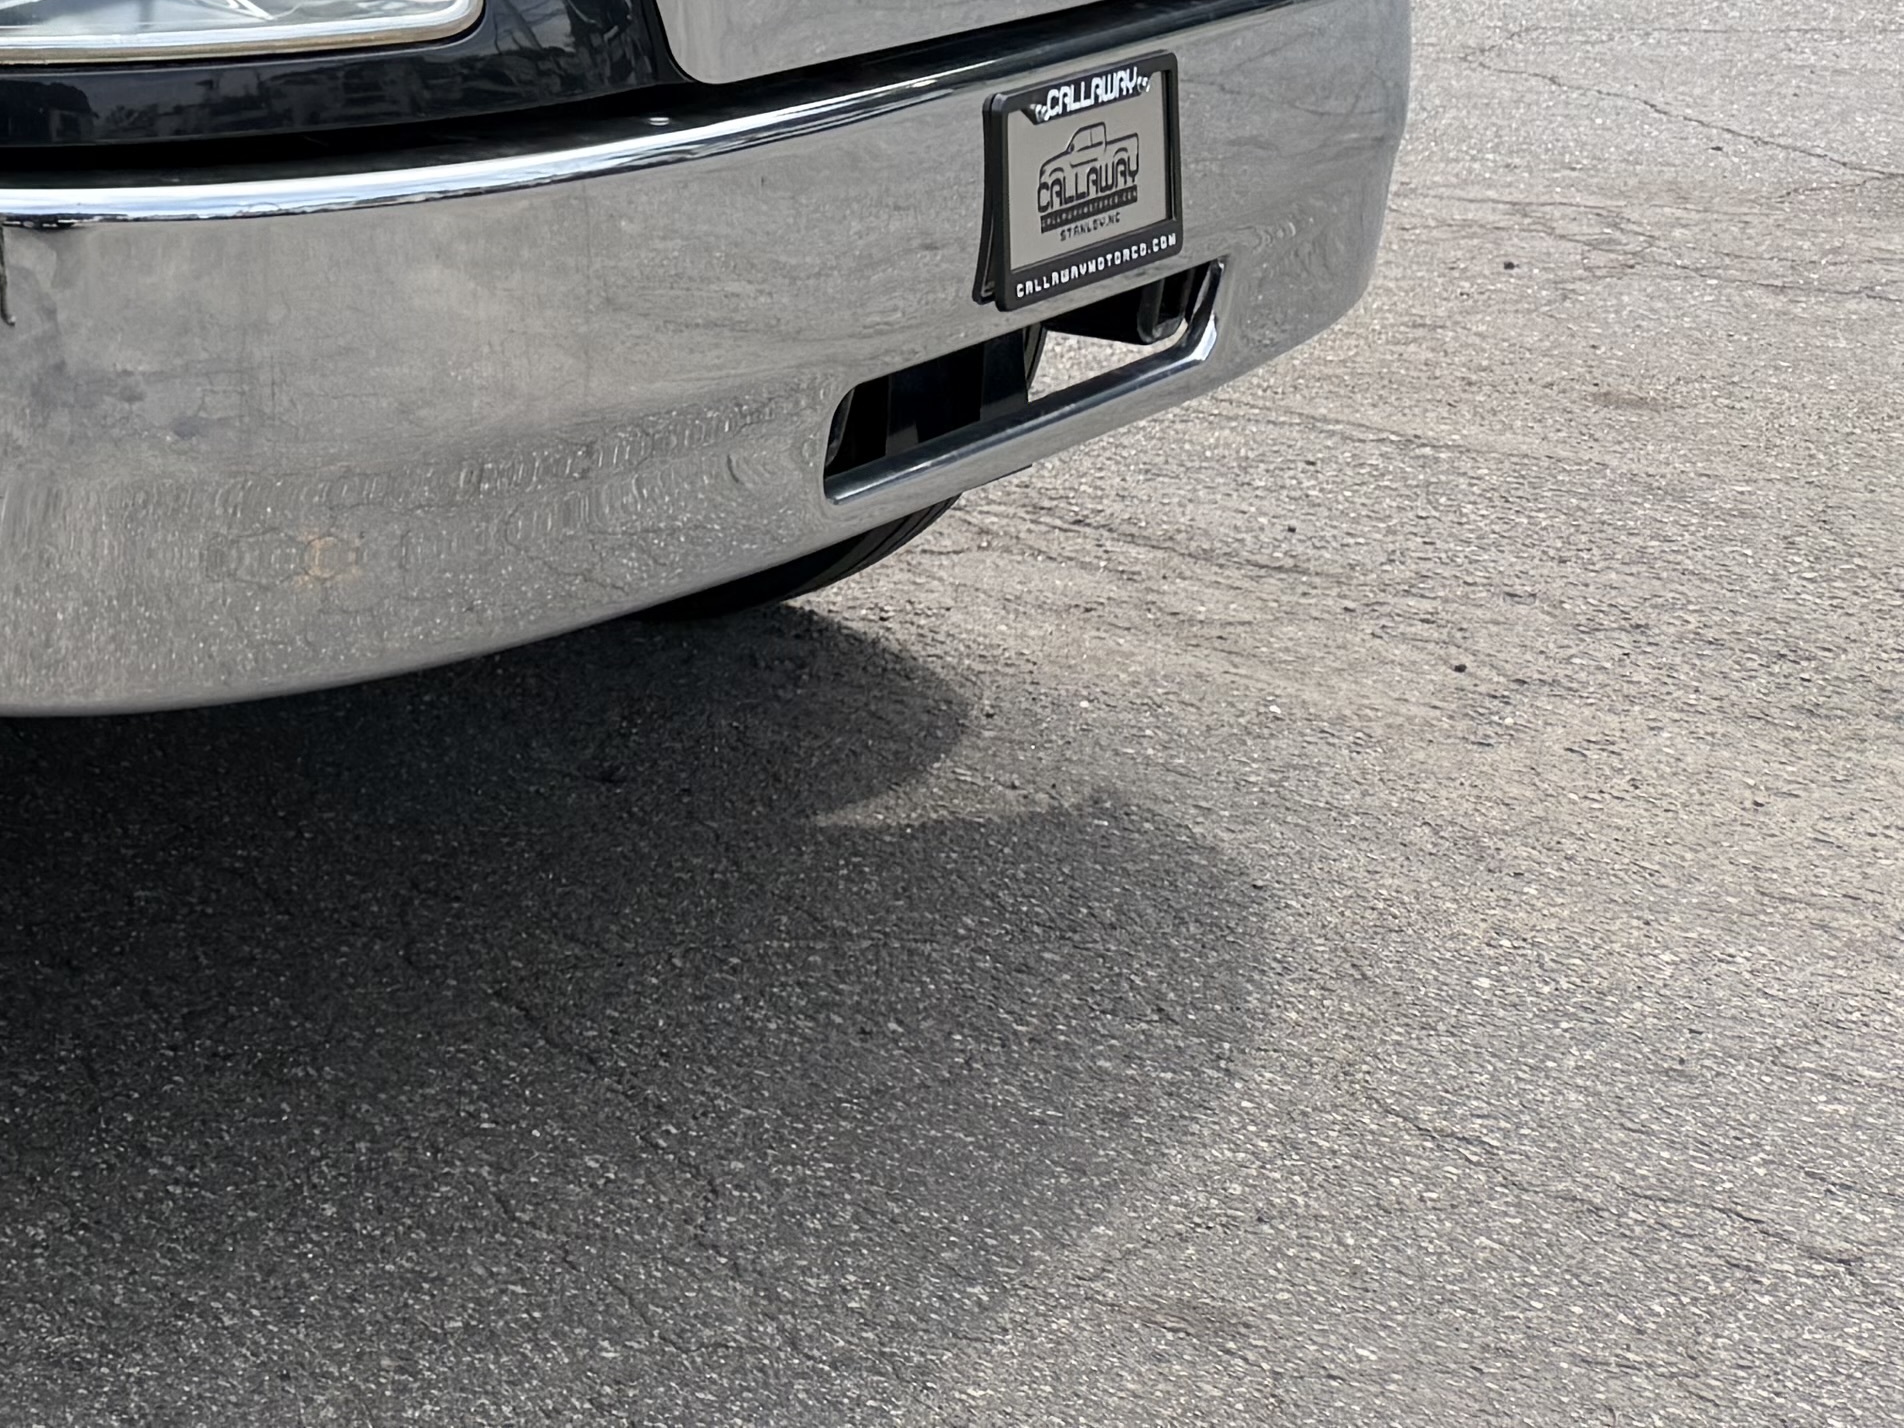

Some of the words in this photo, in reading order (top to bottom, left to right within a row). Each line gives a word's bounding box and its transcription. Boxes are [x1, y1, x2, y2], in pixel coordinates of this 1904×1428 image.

[1046, 66, 1138, 119] CALLAWAY
[1037, 153, 1140, 214] CALLAWAY
[1015, 232, 1177, 299] CALLAWAYMOTORCO.COM
